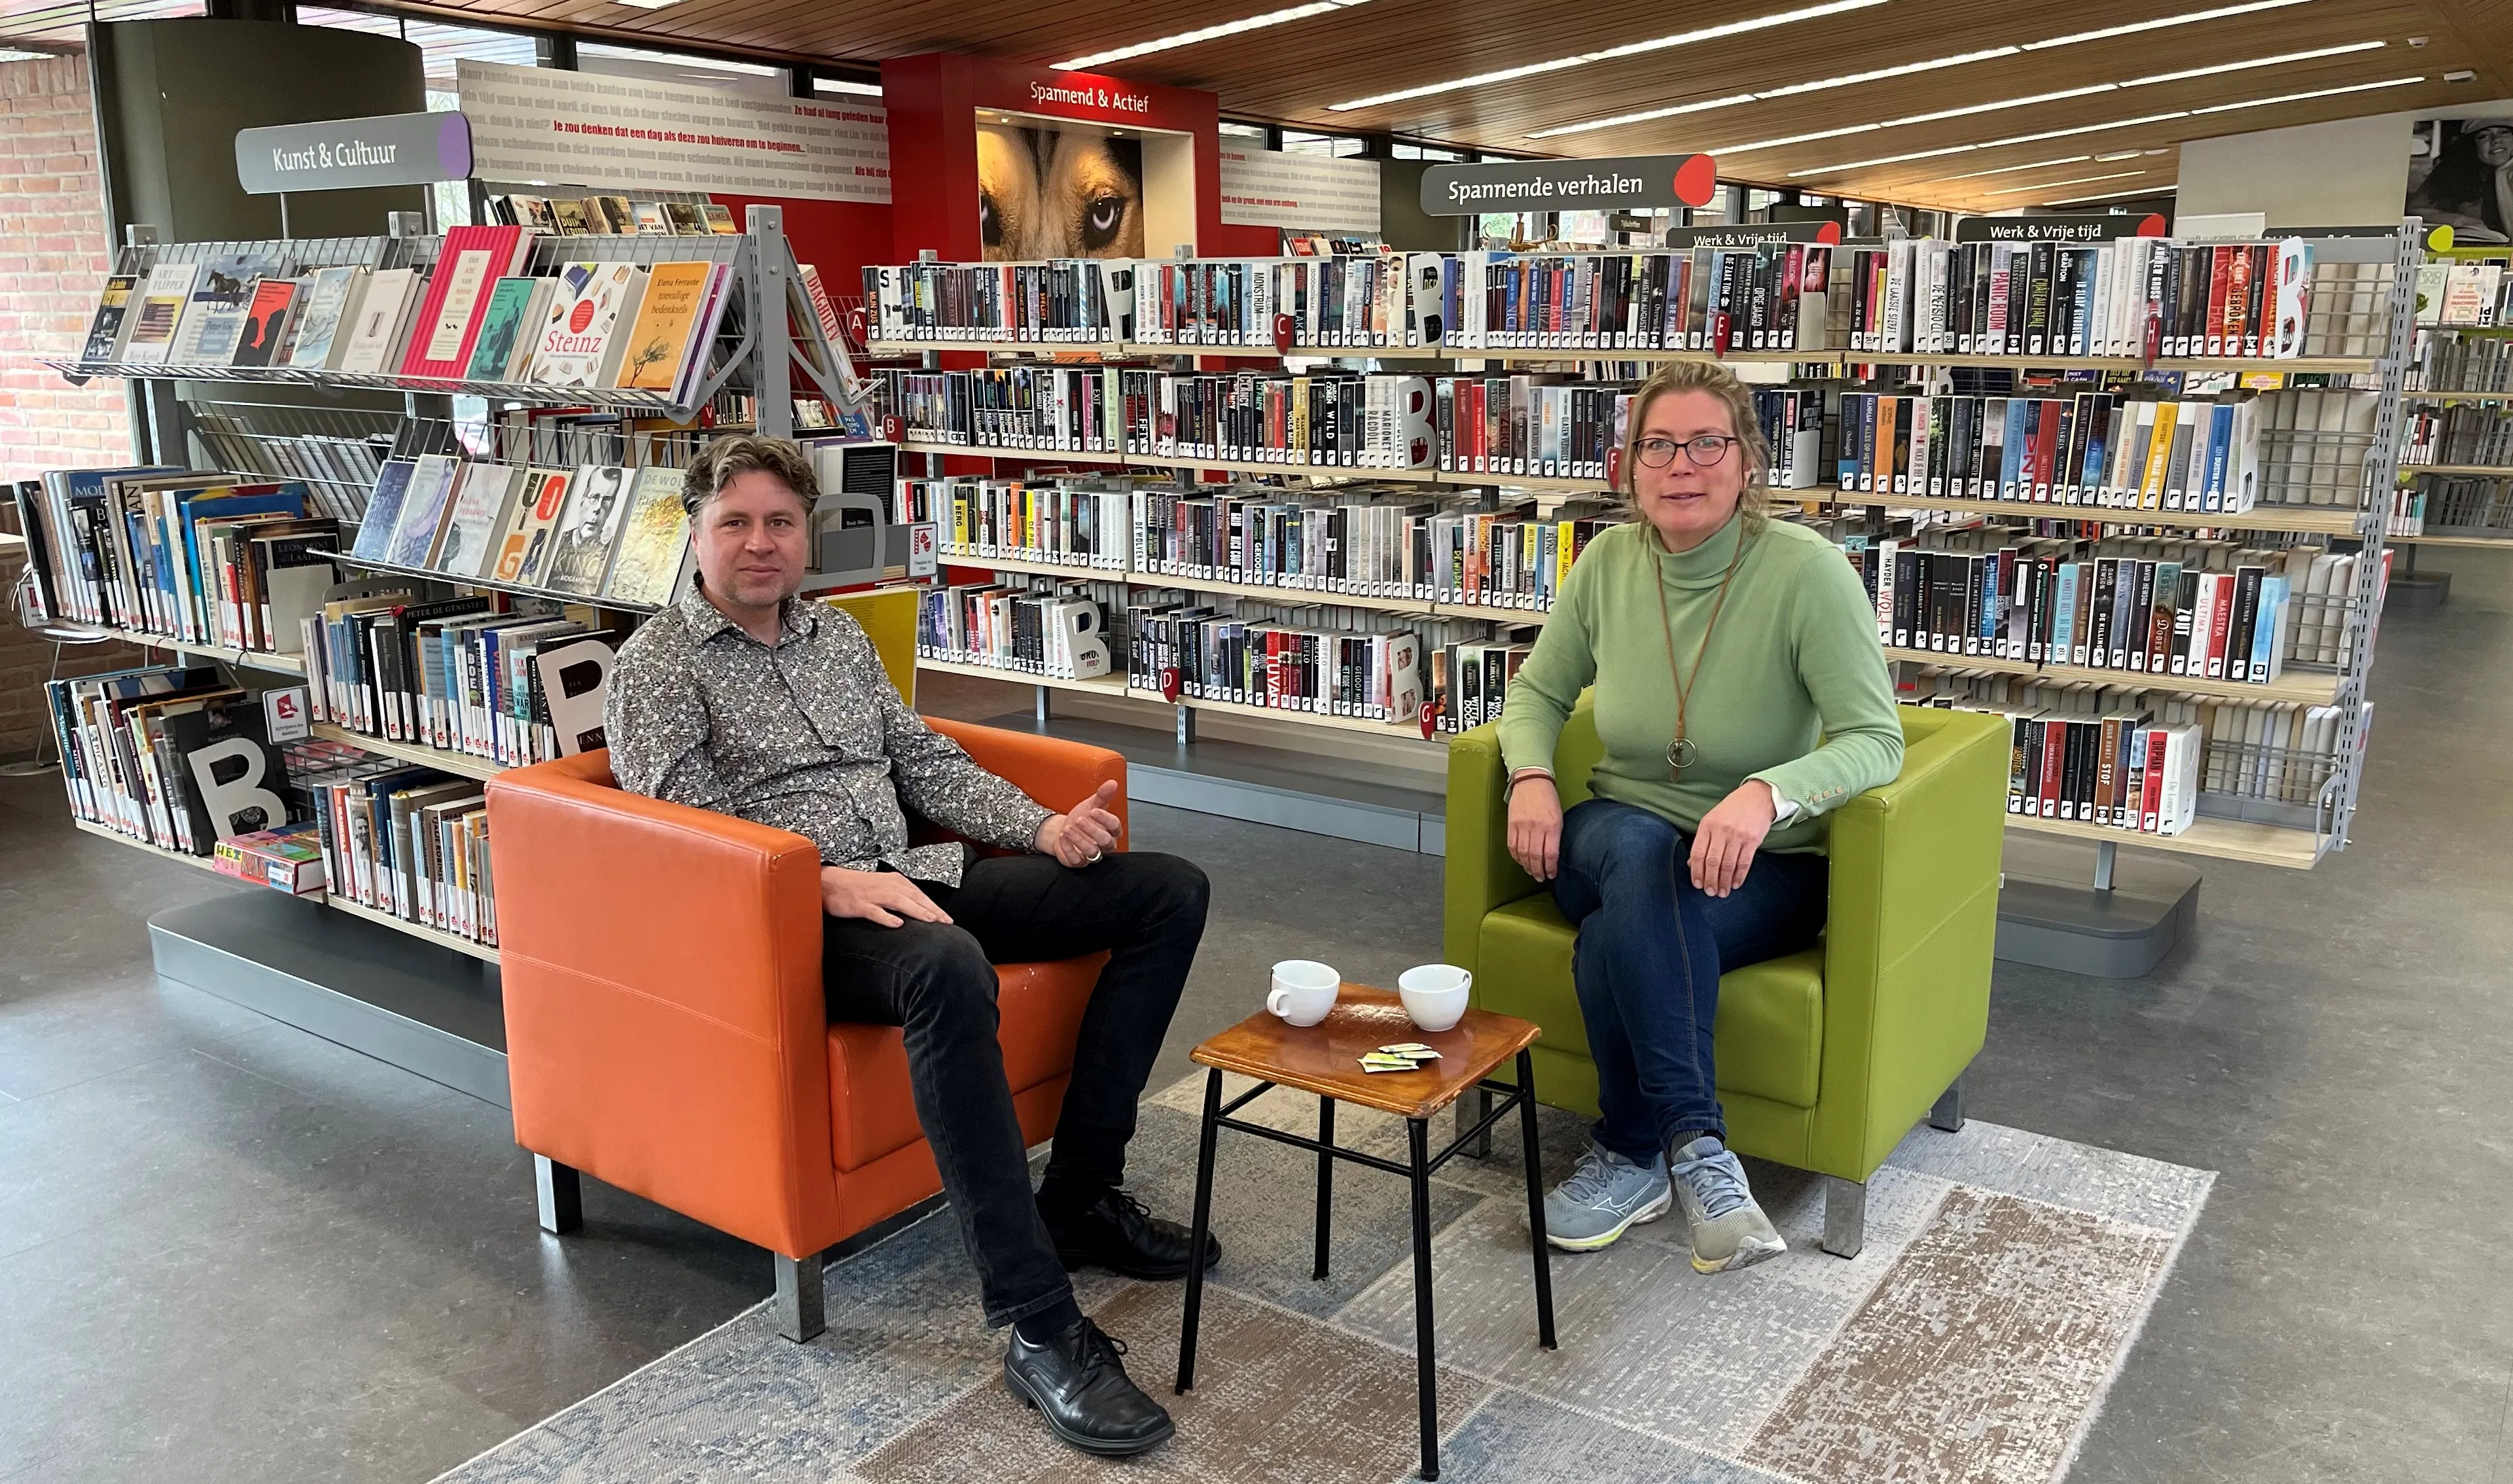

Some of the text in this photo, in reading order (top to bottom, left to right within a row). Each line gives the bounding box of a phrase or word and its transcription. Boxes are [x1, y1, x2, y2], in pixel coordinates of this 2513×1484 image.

[1031, 81, 1149, 113] Spannend & Actief
[826, 108, 840, 120] lang
[842, 111, 868, 122] geleden
[554, 120, 563, 131] Je
[565, 122, 579, 133] zou
[581, 122, 613, 136] denken
[615, 126, 628, 137] dat
[630, 128, 645, 139] een
[647, 129, 662, 141] dag
[664, 131, 675, 141] als
[677, 132, 695, 143] deze
[698, 135, 710, 145] zou
[711, 134, 744, 148] huiveren
[746, 139, 757, 149] om
[273, 140, 397, 171] Kunst & Cultuur
[855, 166, 887, 178] Als hij zijn
[1448, 173, 1643, 205] Spannende verhalen
[705, 212, 730, 222] SAMEN
[1694, 234, 1724, 247] Werk
[1725, 234, 1735, 245] &
[1990, 224, 2101, 241] Werk & Vrije tijd
[156, 270, 174, 279] ART
[1725, 266, 1734, 283] ZAAK
[2059, 252, 2069, 282] GRAFTON
[657, 278, 700, 287] Elena Ferrante
[1254, 272, 1264, 314] MONSTRUM
[1936, 285, 1945, 294] DE
[2150, 276, 2162, 299] GROSS
[658, 291, 690, 302] toevallige
[806, 274, 840, 341] DIAGHILEV
[1891, 288, 1900, 309] LAATSTE
[1989, 272, 2009, 330] PANIC ROOM
[2075, 289, 2086, 307] SLAAP
[651, 303, 688, 315] bedenksels
[2027, 308, 2046, 328] FATALE
[2228, 287, 2243, 336] GEBROKEN
[851, 314, 863, 330] A
[1277, 317, 1287, 335] C
[1717, 316, 1725, 336] E
[1887, 309, 1898, 334] STERFT
[2147, 321, 2156, 344] H
[544, 330, 602, 353] Steinz
[886, 418, 895, 434] B
[1138, 417, 1149, 442] FIFTY
[1326, 410, 1336, 440] WILD
[1367, 410, 1379, 447] RAGDOLL
[1381, 410, 1391, 452] MARIONET
[1972, 438, 1980, 448] DE
[1610, 452, 1616, 472] F
[2152, 453, 2164, 474] VRIJE
[2212, 457, 2222, 480] DUISTER
[644, 474, 657, 484] DE
[1135, 521, 1144, 559] DE WOLVEN
[1289, 510, 1297, 569] Cornwell SCHERP
[1349, 536, 1358, 554] KILL
[1545, 533, 1554, 555] FLYNN
[1493, 544, 1503, 567] FITZEK
[1468, 573, 1476, 589] fixer
[1883, 559, 1892, 587] HAYDER
[2099, 564, 2108, 590] HEWSON
[2141, 581, 2150, 606] HEWSON
[406, 607, 444, 620] PETER DE
[2174, 607, 2192, 637] ZOUT
[2196, 597, 2209, 633] ULTIMA
[2215, 599, 2228, 637] MAESTRA
[1163, 671, 1173, 688] D
[1266, 655, 1281, 696] TUVA
[1421, 705, 1431, 722] G
[92, 739, 108, 789] PICASSO
[2148, 740, 2164, 772] ORPHAN
[2100, 763, 2112, 786] STOF
[2169, 781, 2178, 792] De
